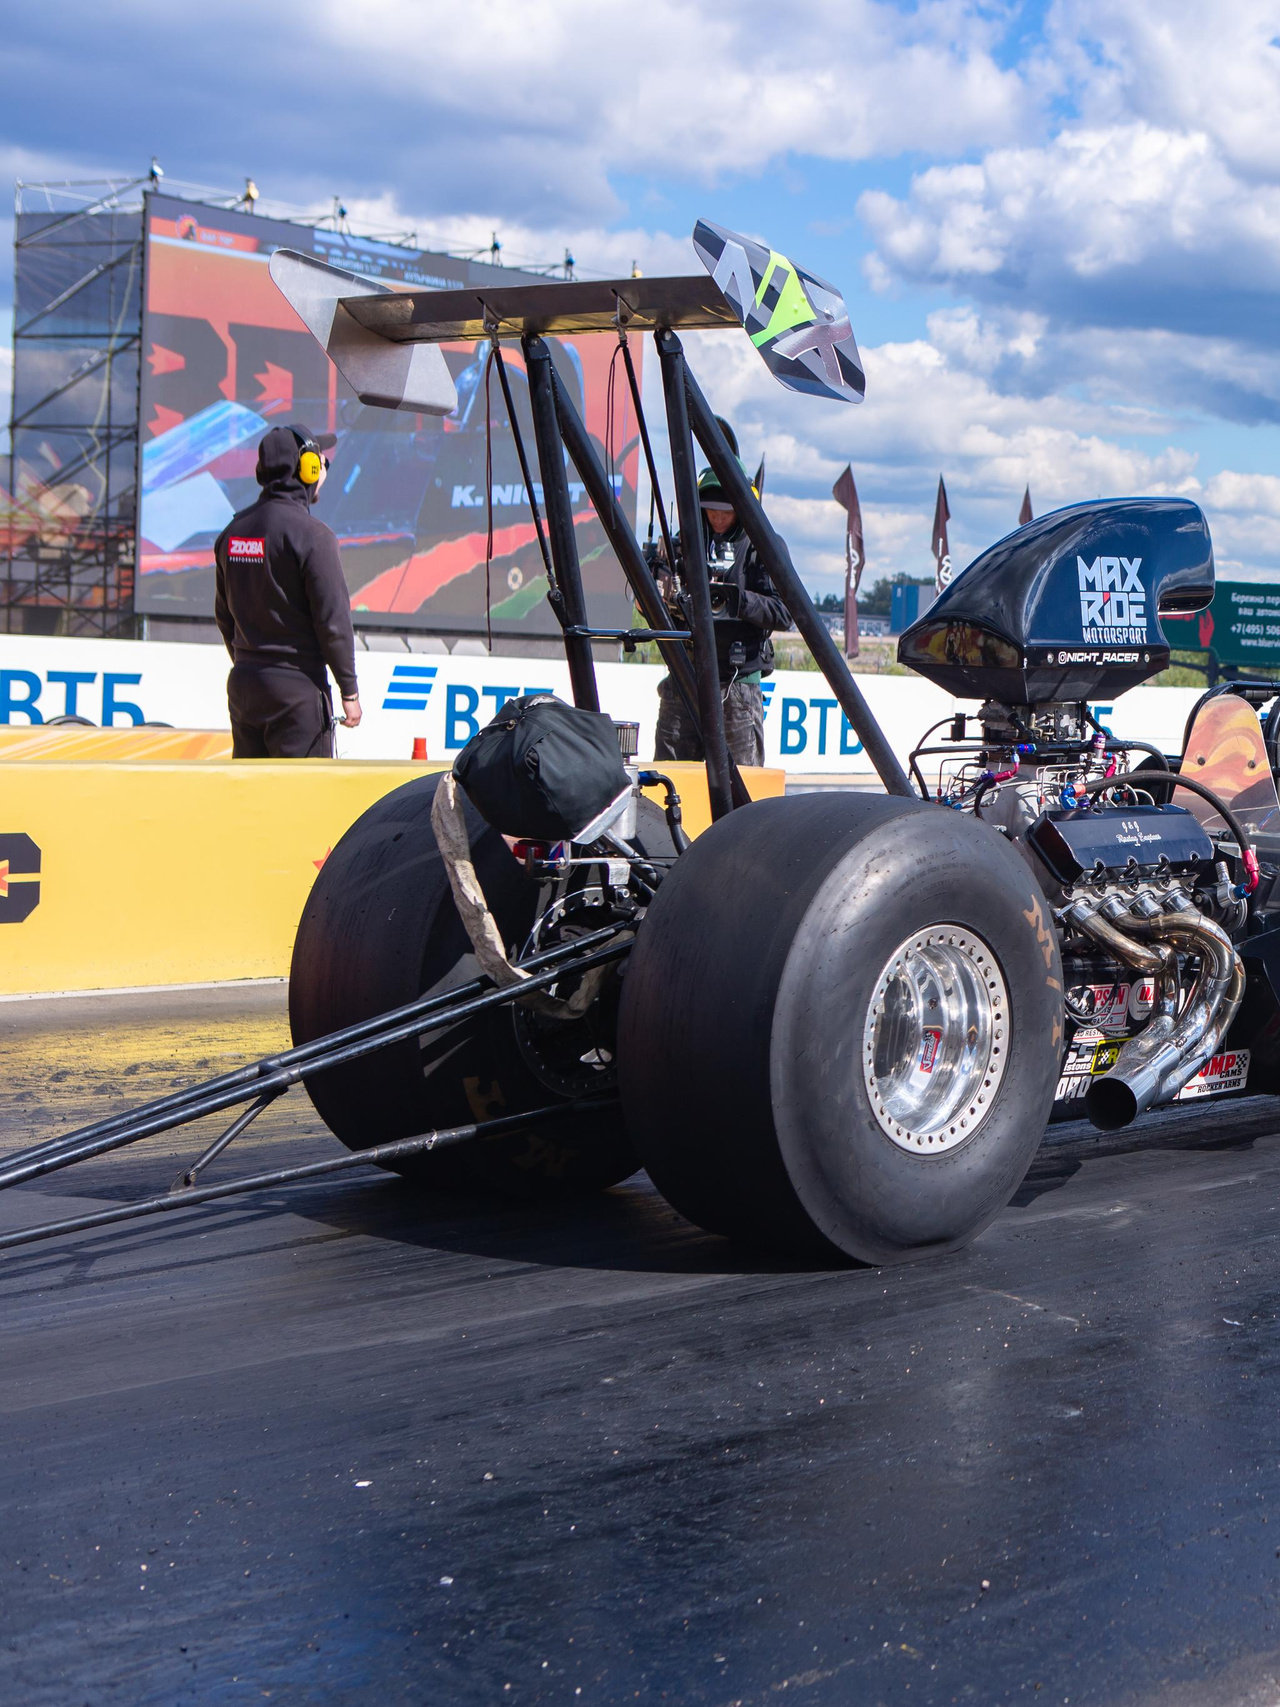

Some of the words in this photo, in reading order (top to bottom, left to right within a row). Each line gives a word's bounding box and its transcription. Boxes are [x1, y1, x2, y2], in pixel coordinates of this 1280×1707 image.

[491, 482, 587, 506] NIGT
[1077, 555, 1146, 592] MAX
[1238, 607, 1254, 616] ваш
[1082, 627, 1148, 644] MOTORSPORT
[1058, 651, 1140, 665] @NIGHT_RACER
[1220, 1068, 1243, 1079] CAMS
[1198, 1081, 1223, 1093] ROCKER
[1223, 1079, 1241, 1089] ARMS
